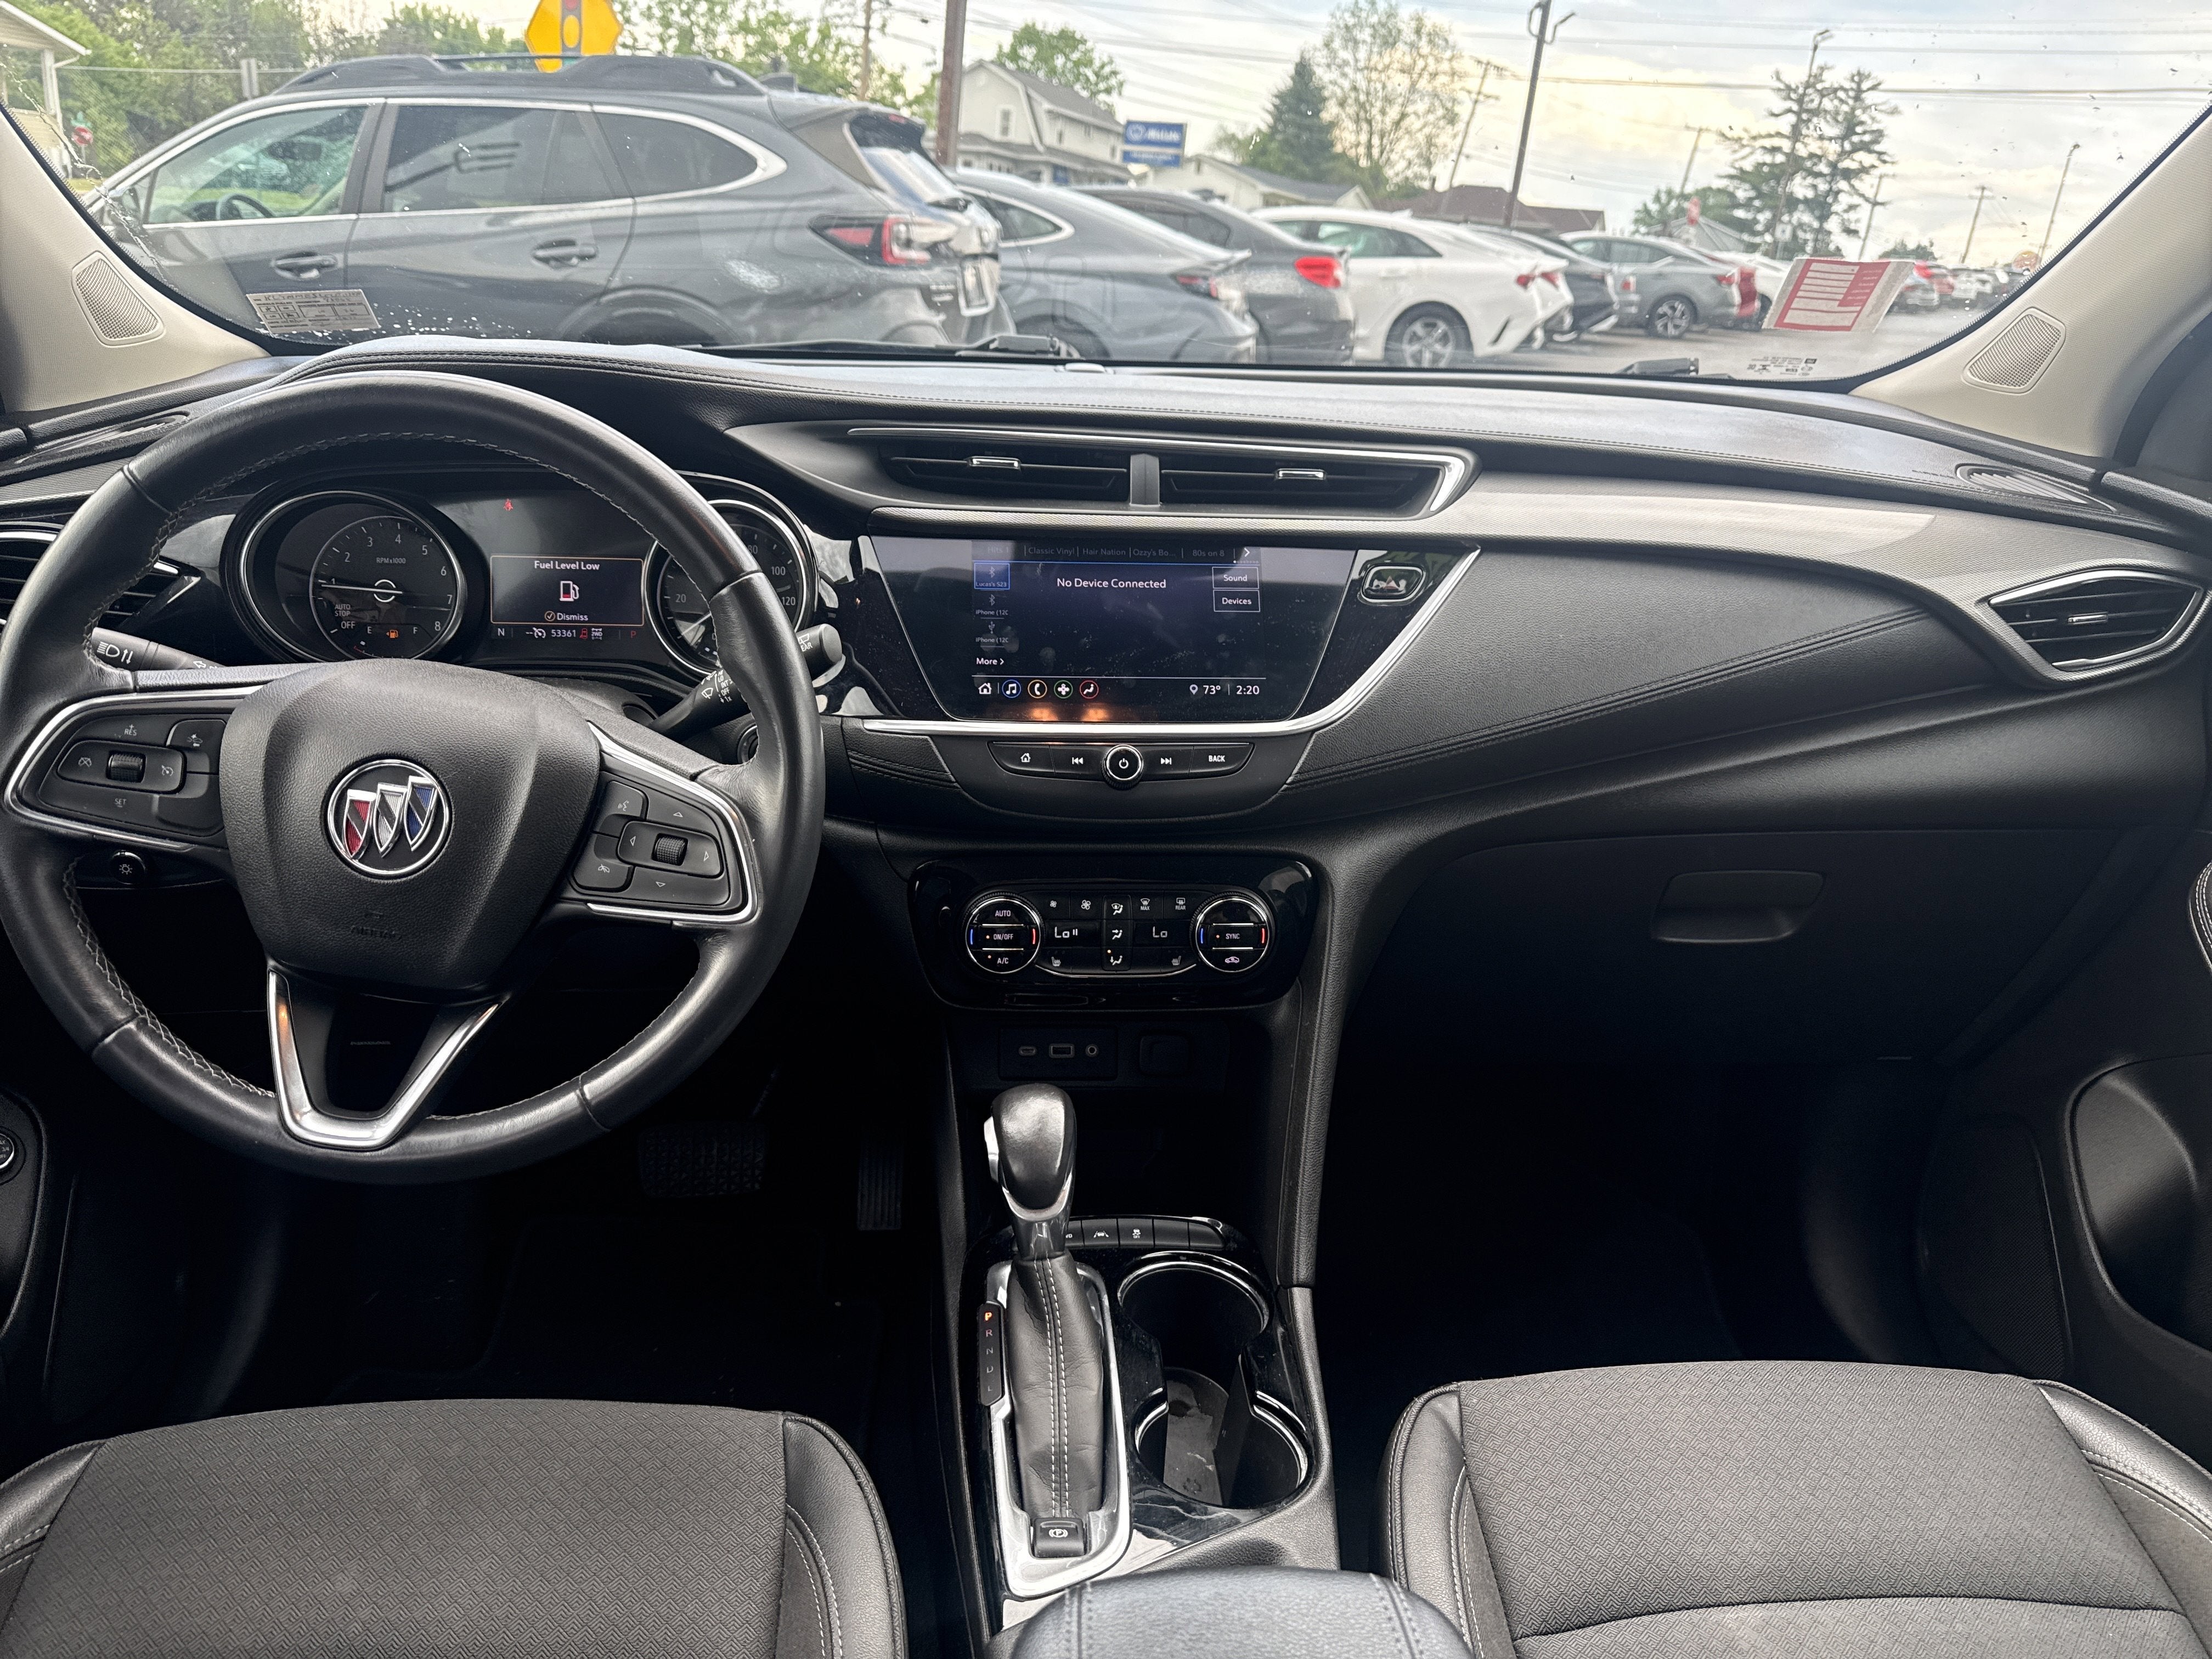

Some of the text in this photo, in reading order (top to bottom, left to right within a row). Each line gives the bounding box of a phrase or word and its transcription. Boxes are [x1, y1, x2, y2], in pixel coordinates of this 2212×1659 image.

[367, 537, 373, 547] 3
[395, 534, 402, 544] 4
[421, 545, 428, 555] 5
[1056, 548, 1075, 556] Vinyl
[1133, 549, 1156, 558] Ozzy's
[345, 552, 351, 562] 2
[534, 561, 600, 570] Fuel Level Low
[441, 566, 447, 576] 6
[771, 566, 786, 575] 100
[1057, 578, 1166, 588] No Device Connected
[447, 594, 453, 605] 7
[675, 594, 686, 603] 20
[782, 596, 796, 606] 120
[557, 612, 588, 621] Dismiss
[435, 622, 441, 631] 8
[801, 642, 813, 652] EAR
[720, 680, 729, 689] INT
[720, 687, 730, 696] OFF
[1236, 685, 1260, 695] 2:20
[124, 728, 137, 736] RES
[1054, 927, 1070, 938] Lo
[1153, 926, 1167, 938] Lo
[985, 1312, 992, 1321] P
[986, 1329, 993, 1338] R
